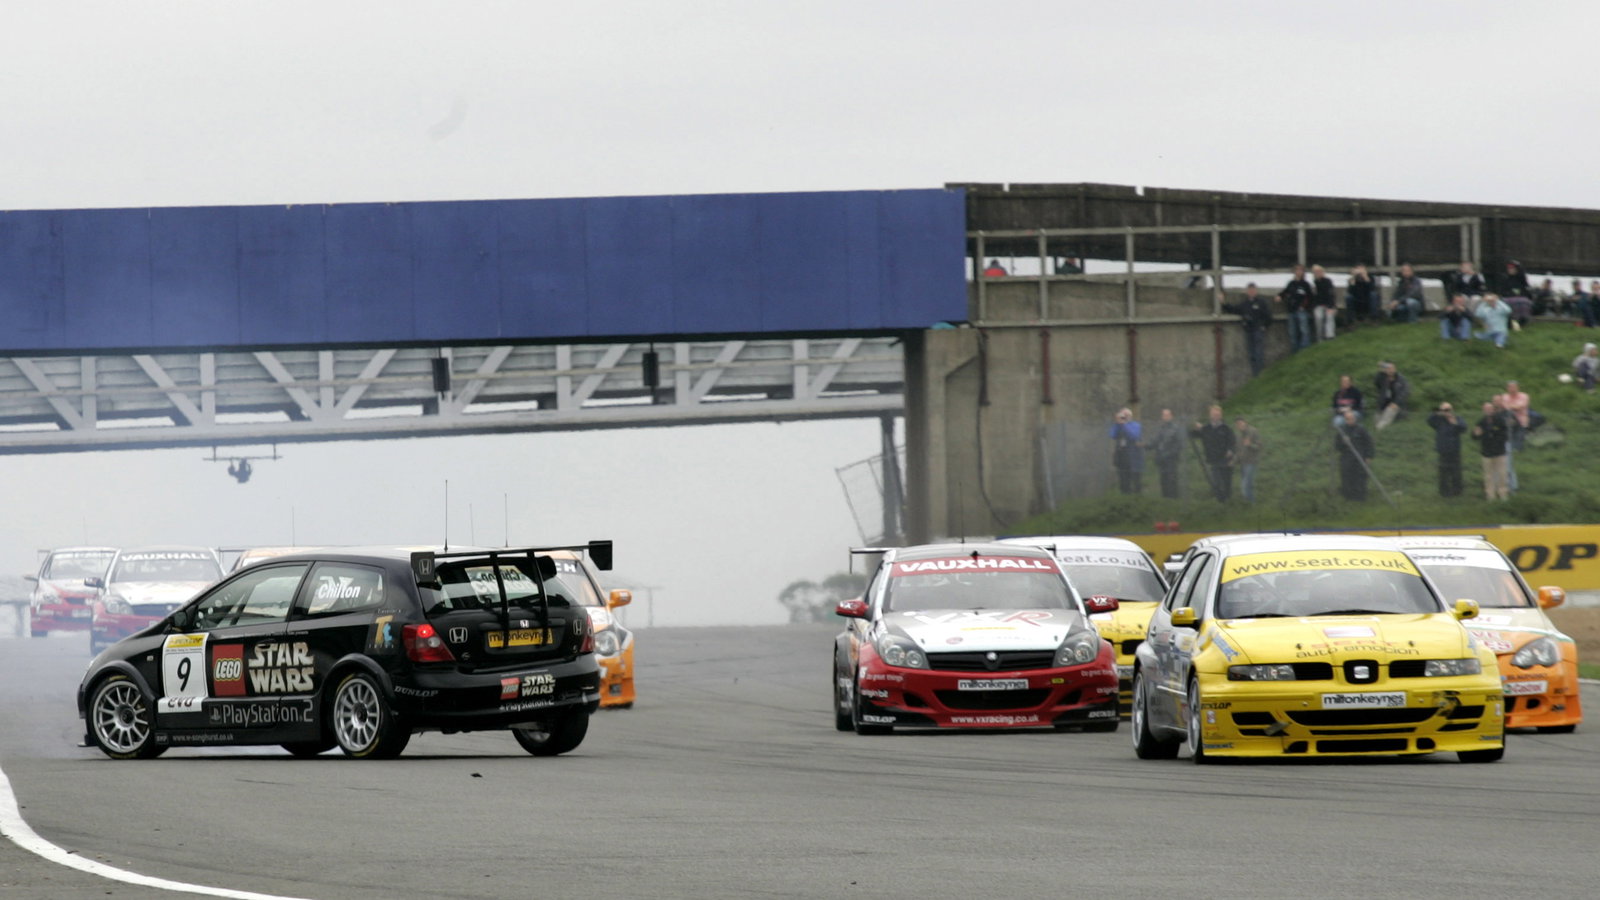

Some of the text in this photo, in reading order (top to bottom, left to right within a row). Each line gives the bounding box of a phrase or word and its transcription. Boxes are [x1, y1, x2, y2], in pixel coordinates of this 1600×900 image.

[121, 552, 211, 562] VAUXHALL
[900, 559, 1052, 573] VAUXHALL
[1232, 556, 1409, 575] www.seat.co.uk
[318, 582, 361, 599] Chilton
[248, 641, 314, 668] STAR
[1295, 646, 1339, 659] auto
[176, 656, 192, 692] 9
[215, 659, 242, 681] LEGO
[248, 667, 315, 694] WARS
[522, 675, 556, 687] STAR
[394, 685, 440, 698] DUNLOP
[521, 684, 555, 697] WARS
[1323, 692, 1405, 704] miltonkeynes
[222, 699, 314, 728] PlayStation 2
[951, 714, 1040, 725] www.vxracing.co.uk
